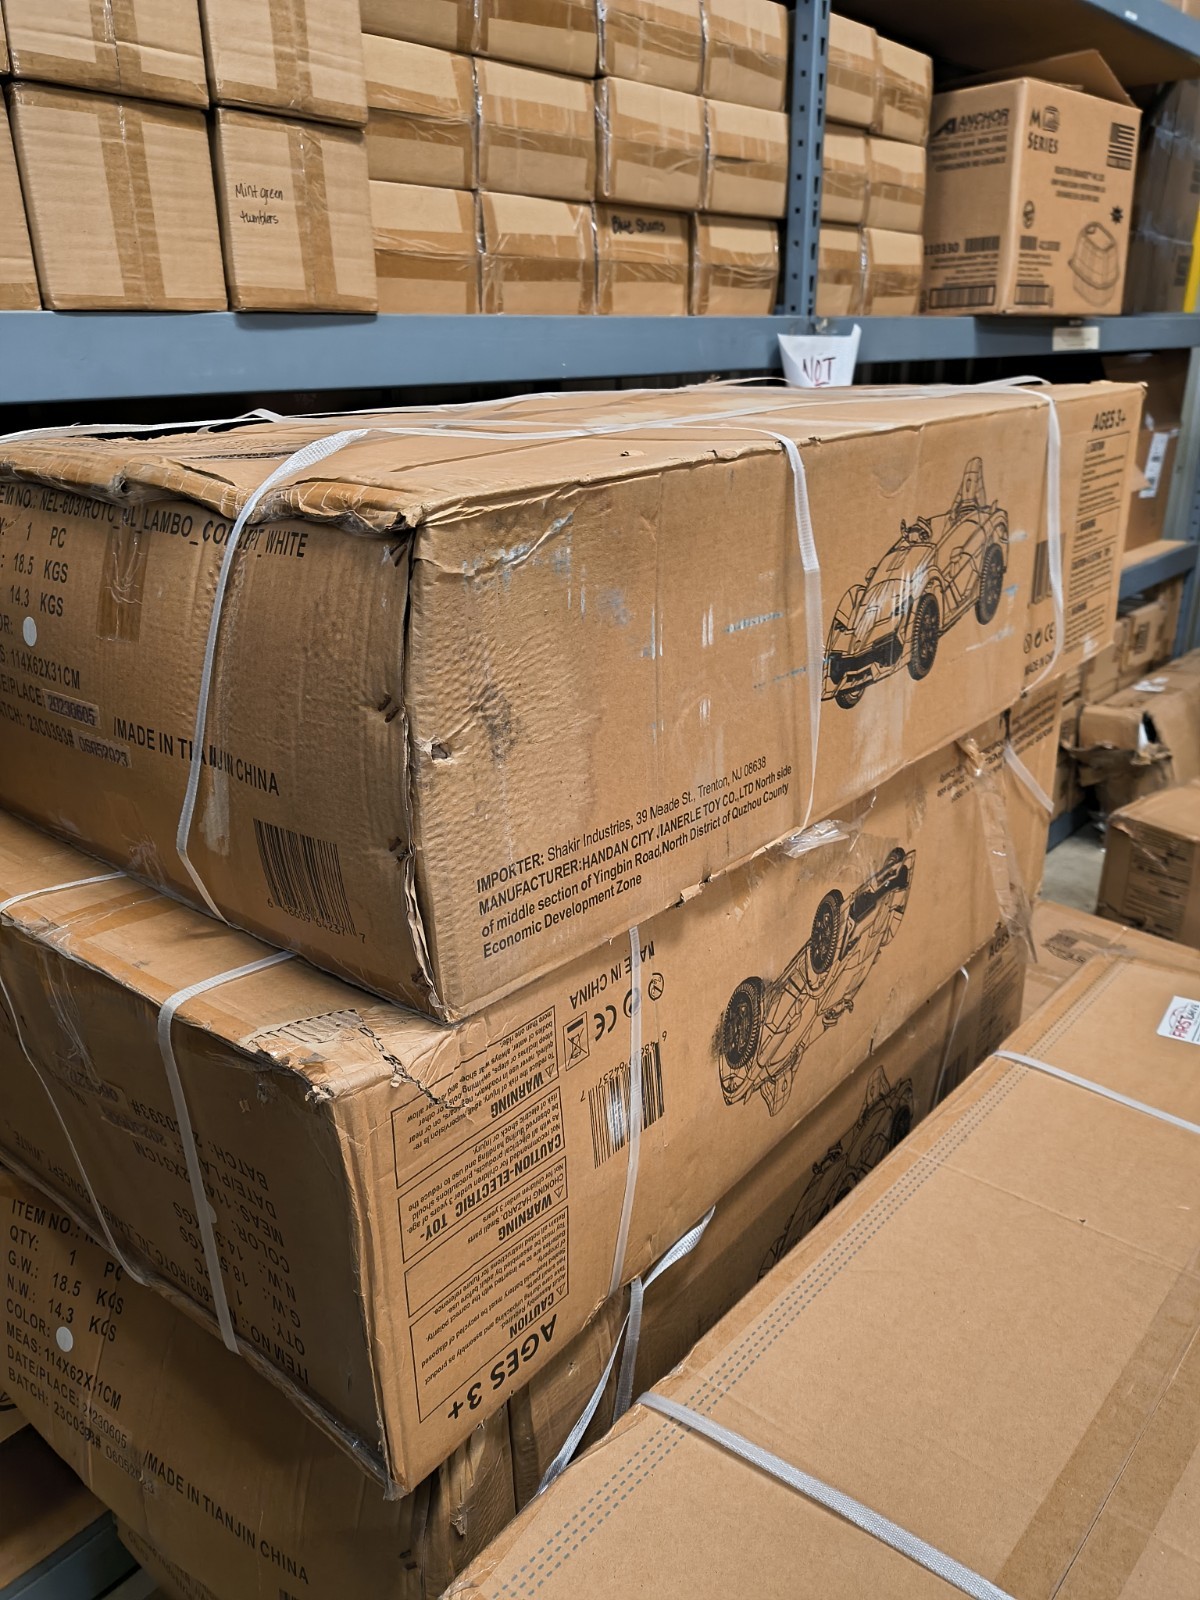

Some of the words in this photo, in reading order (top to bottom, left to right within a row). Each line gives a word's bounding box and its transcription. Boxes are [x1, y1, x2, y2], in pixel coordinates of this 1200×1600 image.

[1027, 132, 1059, 154] SERIES
[235, 182, 258, 199] Mint
[260, 187, 283, 206] green
[240, 209, 279, 225] tumblers
[802, 356, 837, 384] NOT
[1092, 409, 1114, 432] AGES
[27, 522, 32, 541] 1
[49, 526, 66, 548] PC
[14, 553, 34, 575] 18.5
[43, 559, 68, 583] KGS
[10, 585, 30, 608] 14.3
[40, 592, 64, 617] KGS
[11, 649, 80, 690] 114X62X31CM
[159, 732, 174, 756] IN
[236, 758, 280, 796] CHINA
[628, 826, 657, 850] CITY
[700, 797, 724, 815] TOY
[750, 771, 779, 790] North
[771, 763, 795, 780] side
[476, 851, 545, 892] IMPORTER:
[546, 835, 582, 862] Shakir
[581, 815, 634, 849] Industries,
[632, 808, 650, 825] 39
[646, 795, 681, 819] Meade
[695, 774, 731, 798] Trenton,
[727, 766, 747, 782] NJ
[739, 756, 770, 776] 08638
[480, 919, 494, 938] of
[495, 901, 536, 930] middle
[536, 882, 579, 911] section
[578, 874, 594, 891] of
[592, 857, 634, 886] Yingbin
[686, 814, 723, 841] District
[718, 809, 735, 824] of
[728, 795, 765, 820] Quzhou
[759, 780, 793, 805] County
[482, 919, 542, 958] Economic
[543, 884, 616, 929] Development
[613, 871, 643, 894] Zone
[611, 963, 622, 984] IN
[570, 974, 607, 1009] CHINA
[490, 1070, 543, 1118] WARNING
[540, 1100, 546, 1110] of
[547, 1092, 557, 1104] risk
[551, 1102, 558, 1112] be
[500, 1119, 518, 1138] shock
[519, 1105, 539, 1124] electric
[525, 1107, 550, 1131] observed
[550, 1122, 560, 1134] Not
[472, 1137, 491, 1157] injury.
[492, 1133, 499, 1143] or
[505, 1124, 524, 1146] during
[509, 1130, 549, 1162] recommended
[208, 1140, 269, 1191] BATCH:
[464, 1158, 476, 1173] and
[477, 1138, 503, 1164] handling
[499, 1158, 508, 1170] for
[443, 1176, 450, 1187] to
[452, 1167, 463, 1181] use
[454, 1133, 560, 1218] CAUTION-ELECTRIC
[473, 1164, 498, 1187] children
[532, 1171, 563, 1200] CHOKING
[408, 1199, 419, 1213] the
[420, 1183, 442, 1204] reduce
[448, 1196, 452, 1206] 3
[453, 1182, 472, 1202] under
[12, 1199, 46, 1227] ITEM
[48, 1213, 81, 1239] NO.:
[421, 1214, 428, 1226] of
[429, 1198, 447, 1219] years
[498, 1191, 551, 1242] WARNING
[499, 1204, 502, 1212] 3
[500, 1193, 531, 1222] HAZARD.
[234, 1201, 284, 1248] MEAS:
[406, 1218, 420, 1236] age.
[419, 1211, 447, 1245] TOY-
[10, 1225, 39, 1251] QTY:
[70, 1250, 77, 1266] 1
[104, 1261, 123, 1282] PC
[215, 1231, 244, 1262] 14.3
[231, 1220, 290, 1274] COLOR:
[8, 1250, 38, 1279] G.W.:
[53, 1272, 82, 1297] 18.5
[220, 1256, 248, 1287] 18.5
[7, 1273, 35, 1303] N.W.:
[48, 1299, 74, 1324] 14.3
[236, 1289, 242, 1306] 1
[6, 1298, 50, 1338] COLOR:
[509, 1291, 553, 1339] CAUTION
[6, 1321, 41, 1356] MEAS:
[272, 1317, 305, 1356] QTY:
[275, 1343, 309, 1386] ITEM
[489, 1311, 557, 1393] AGES
[7, 1344, 79, 1408] DATE/PLACE:
[9, 1367, 49, 1406] BATCH:
[447, 1379, 482, 1432] 3+
[188, 1483, 200, 1506] IN
[203, 1495, 255, 1549] TIANJIN
[260, 1540, 309, 1584] CHINA
